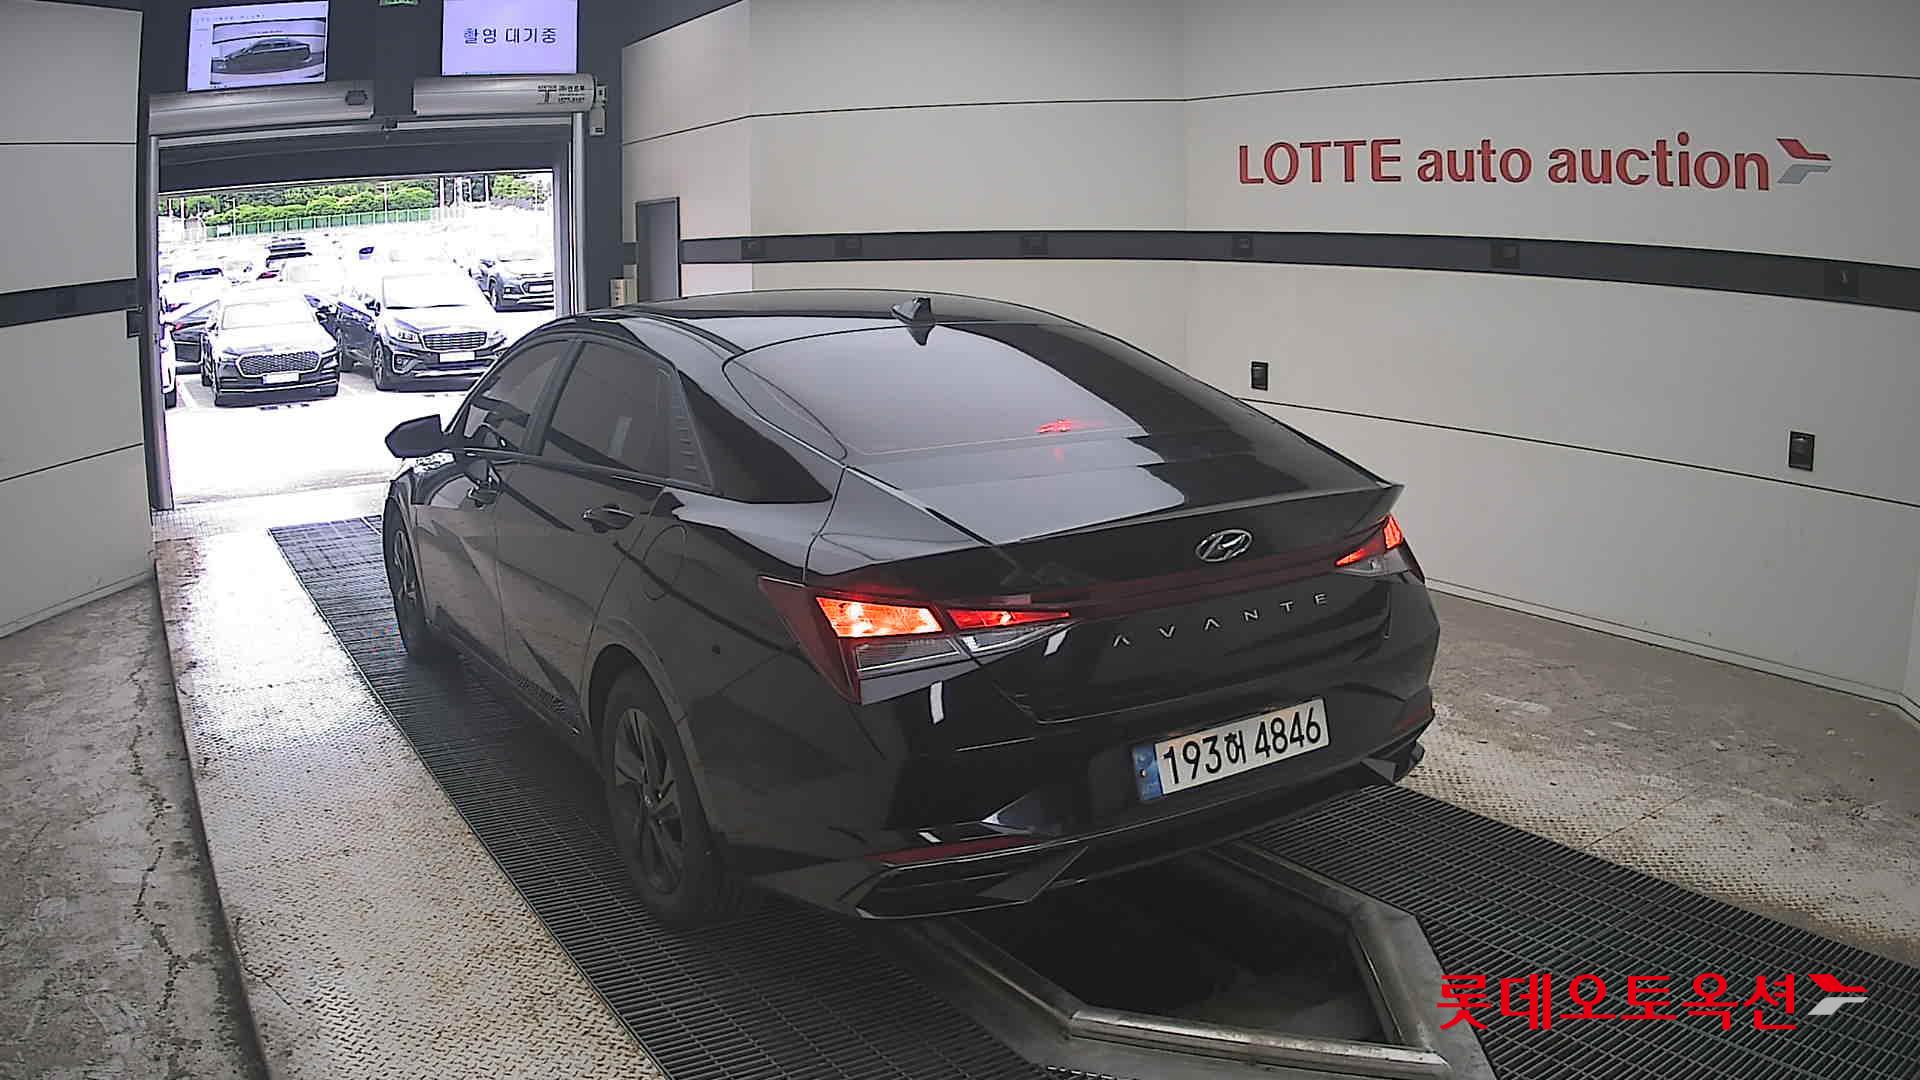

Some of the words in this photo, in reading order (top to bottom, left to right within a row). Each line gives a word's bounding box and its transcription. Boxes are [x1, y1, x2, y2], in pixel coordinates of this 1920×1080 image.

[505, 28, 556, 43] 대기중
[1239, 138, 1401, 185] LOTTE
[1417, 138, 1532, 184] auto
[1548, 131, 1770, 191] auction
[1112, 593, 1327, 647] AVANTE
[1163, 731, 1247, 785] 193허
[1254, 707, 1321, 759] 4846
